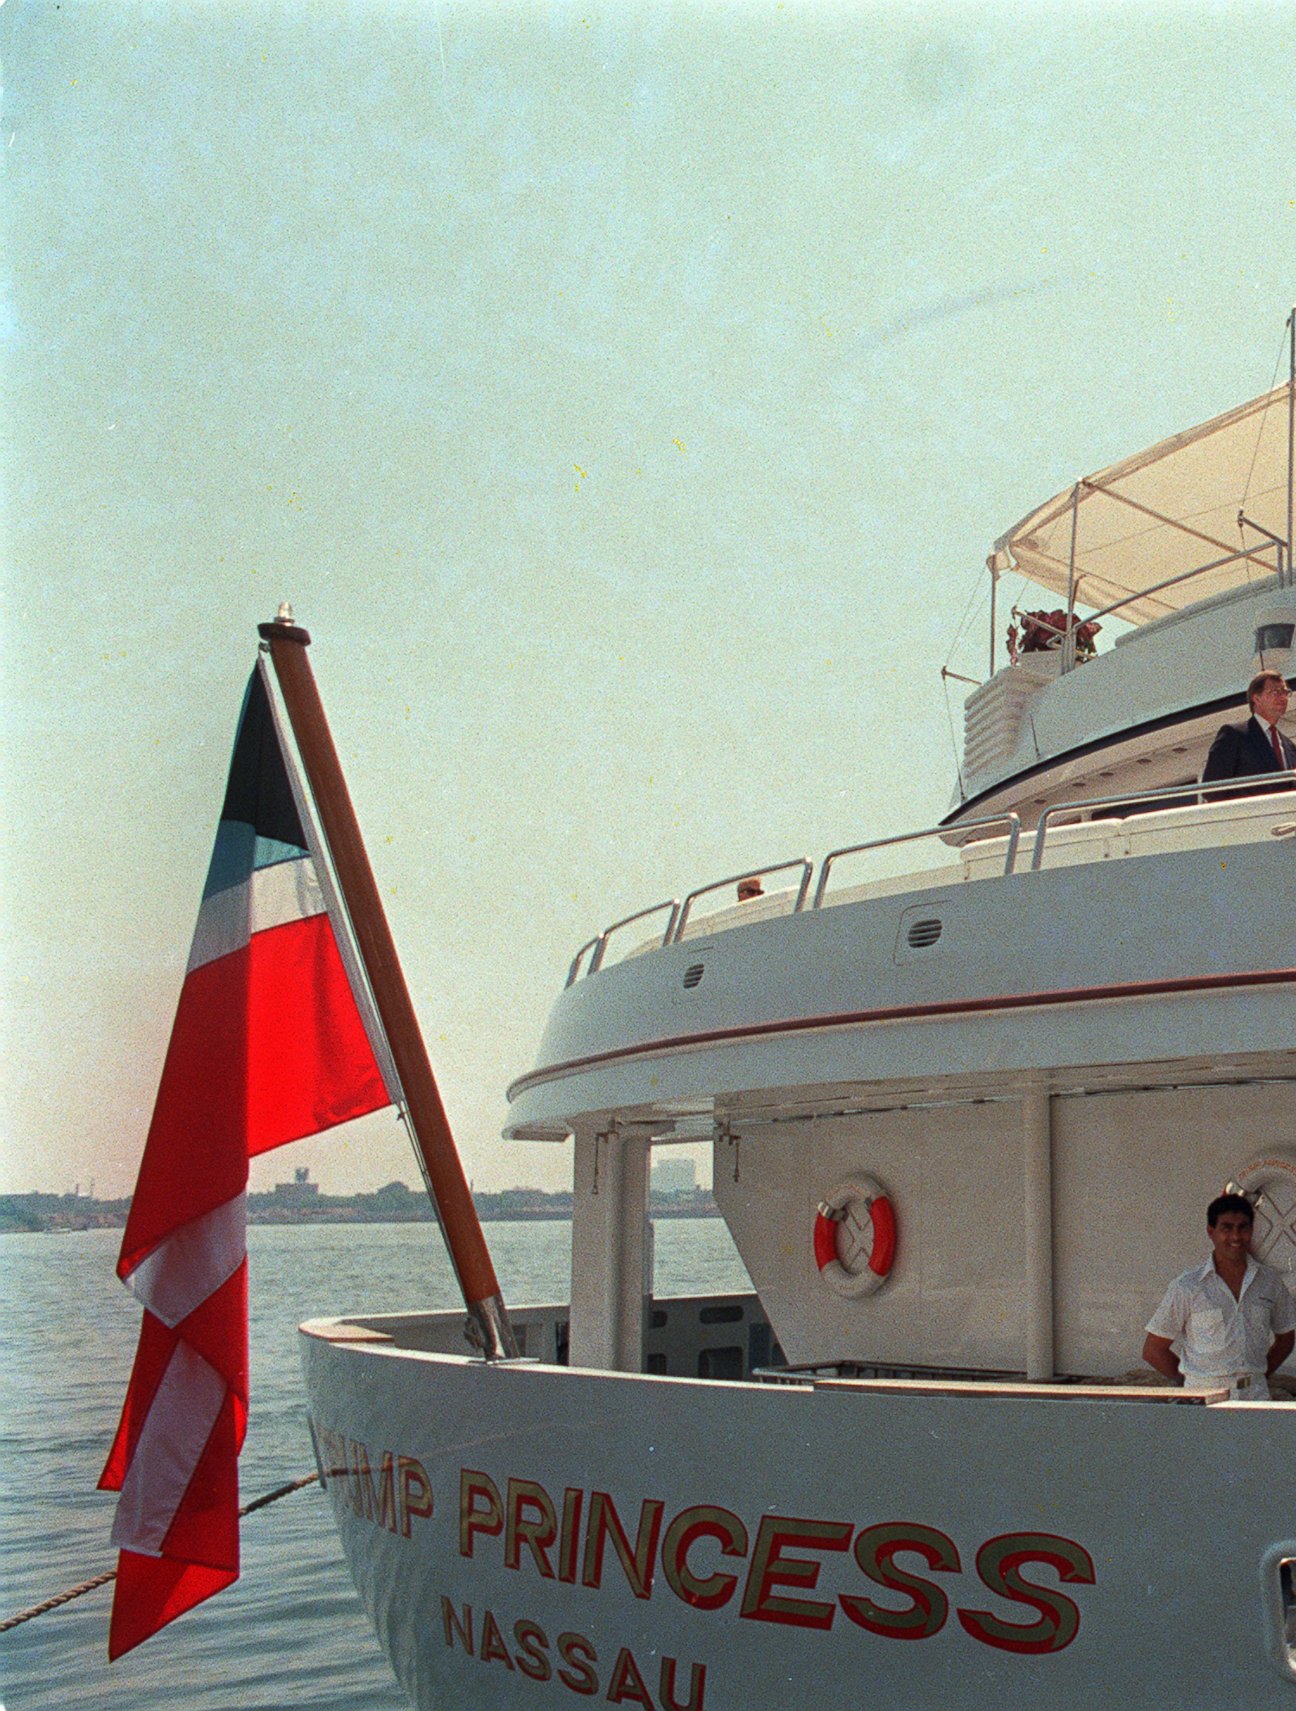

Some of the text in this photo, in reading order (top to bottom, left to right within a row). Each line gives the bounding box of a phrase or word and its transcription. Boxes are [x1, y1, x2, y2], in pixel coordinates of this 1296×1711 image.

[317, 1425, 1096, 1655] UMP PRINCESS
[441, 1595, 707, 1711] NASSAU
